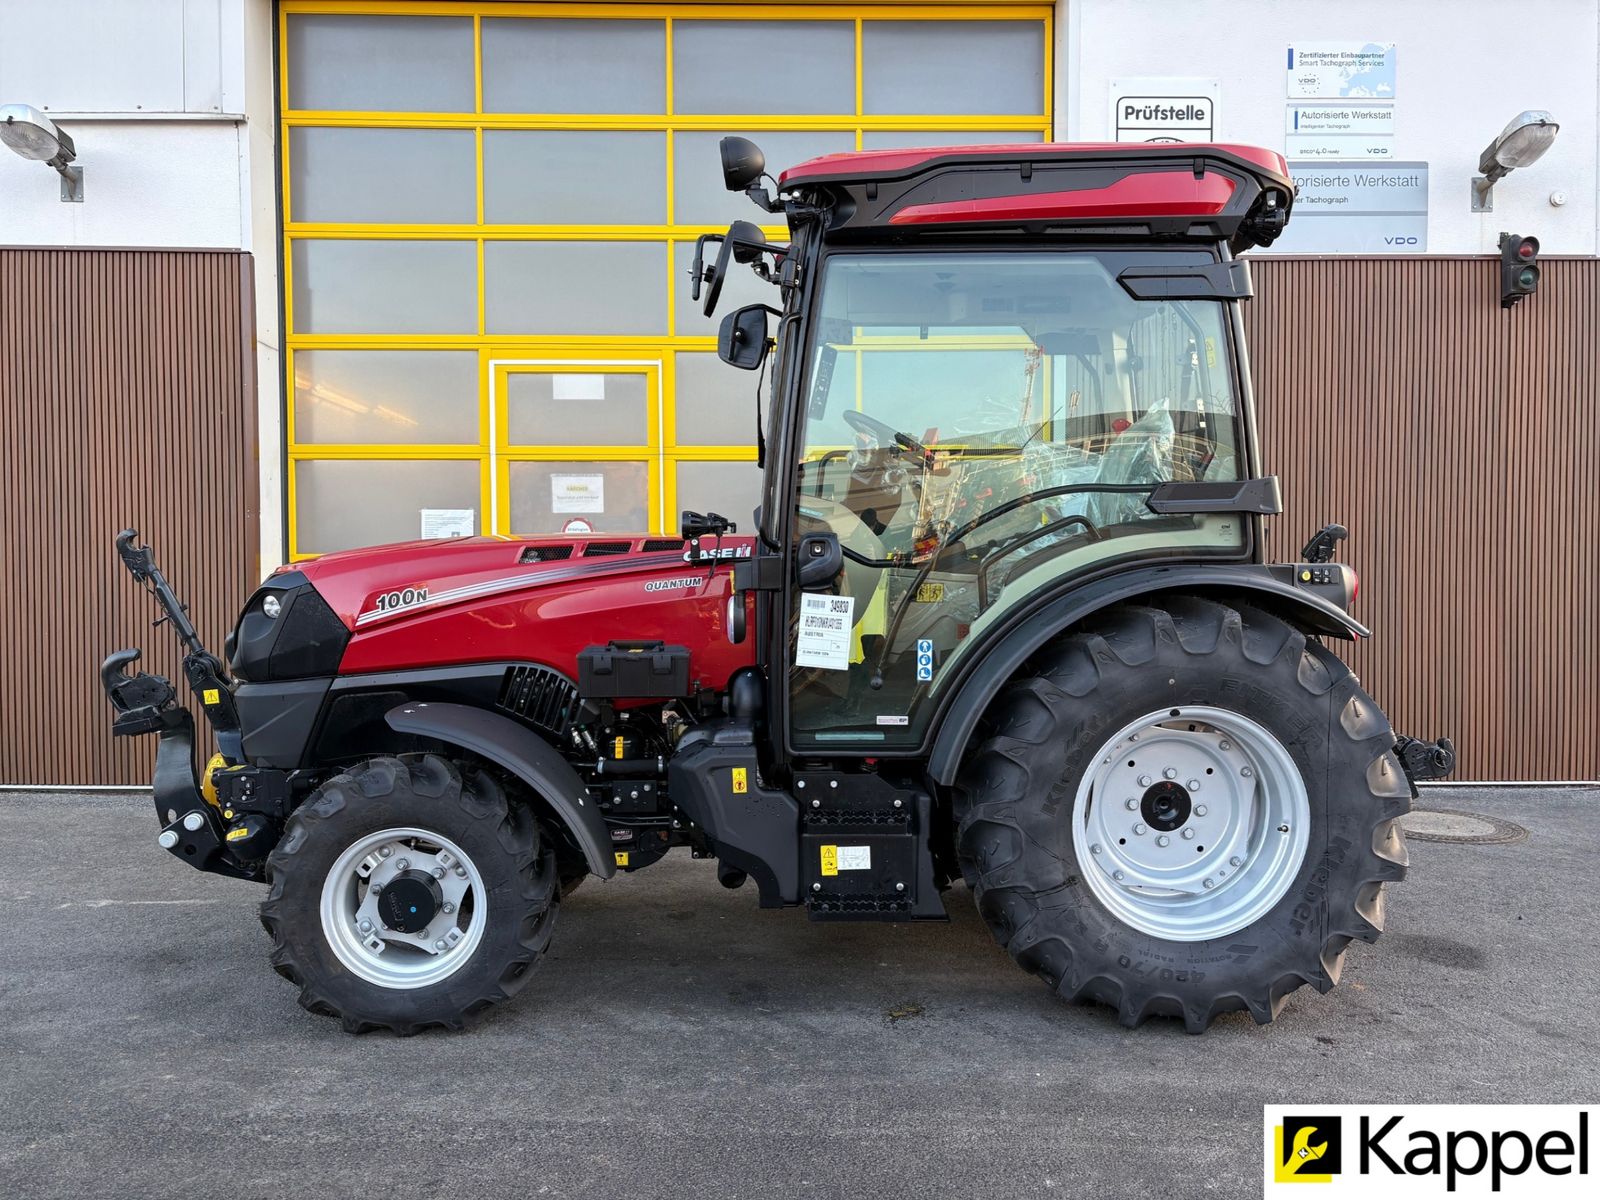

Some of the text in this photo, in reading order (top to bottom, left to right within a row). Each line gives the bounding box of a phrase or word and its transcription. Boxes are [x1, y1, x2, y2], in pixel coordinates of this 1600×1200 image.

[1299, 51, 1385, 60] Zertifizierter Einbaupartner
[1299, 59, 1385, 68] Smart Tachograph Services
[1124, 104, 1205, 121] Prüfstelle
[1301, 111, 1392, 119] Autorisierte Werkstatt
[1292, 174, 1420, 187] torisierte Werkstatt
[1305, 196, 1349, 204] Tachograph
[1384, 237, 1418, 245] VDO
[644, 577, 703, 592] QUANTUM
[376, 588, 428, 611] 100N
